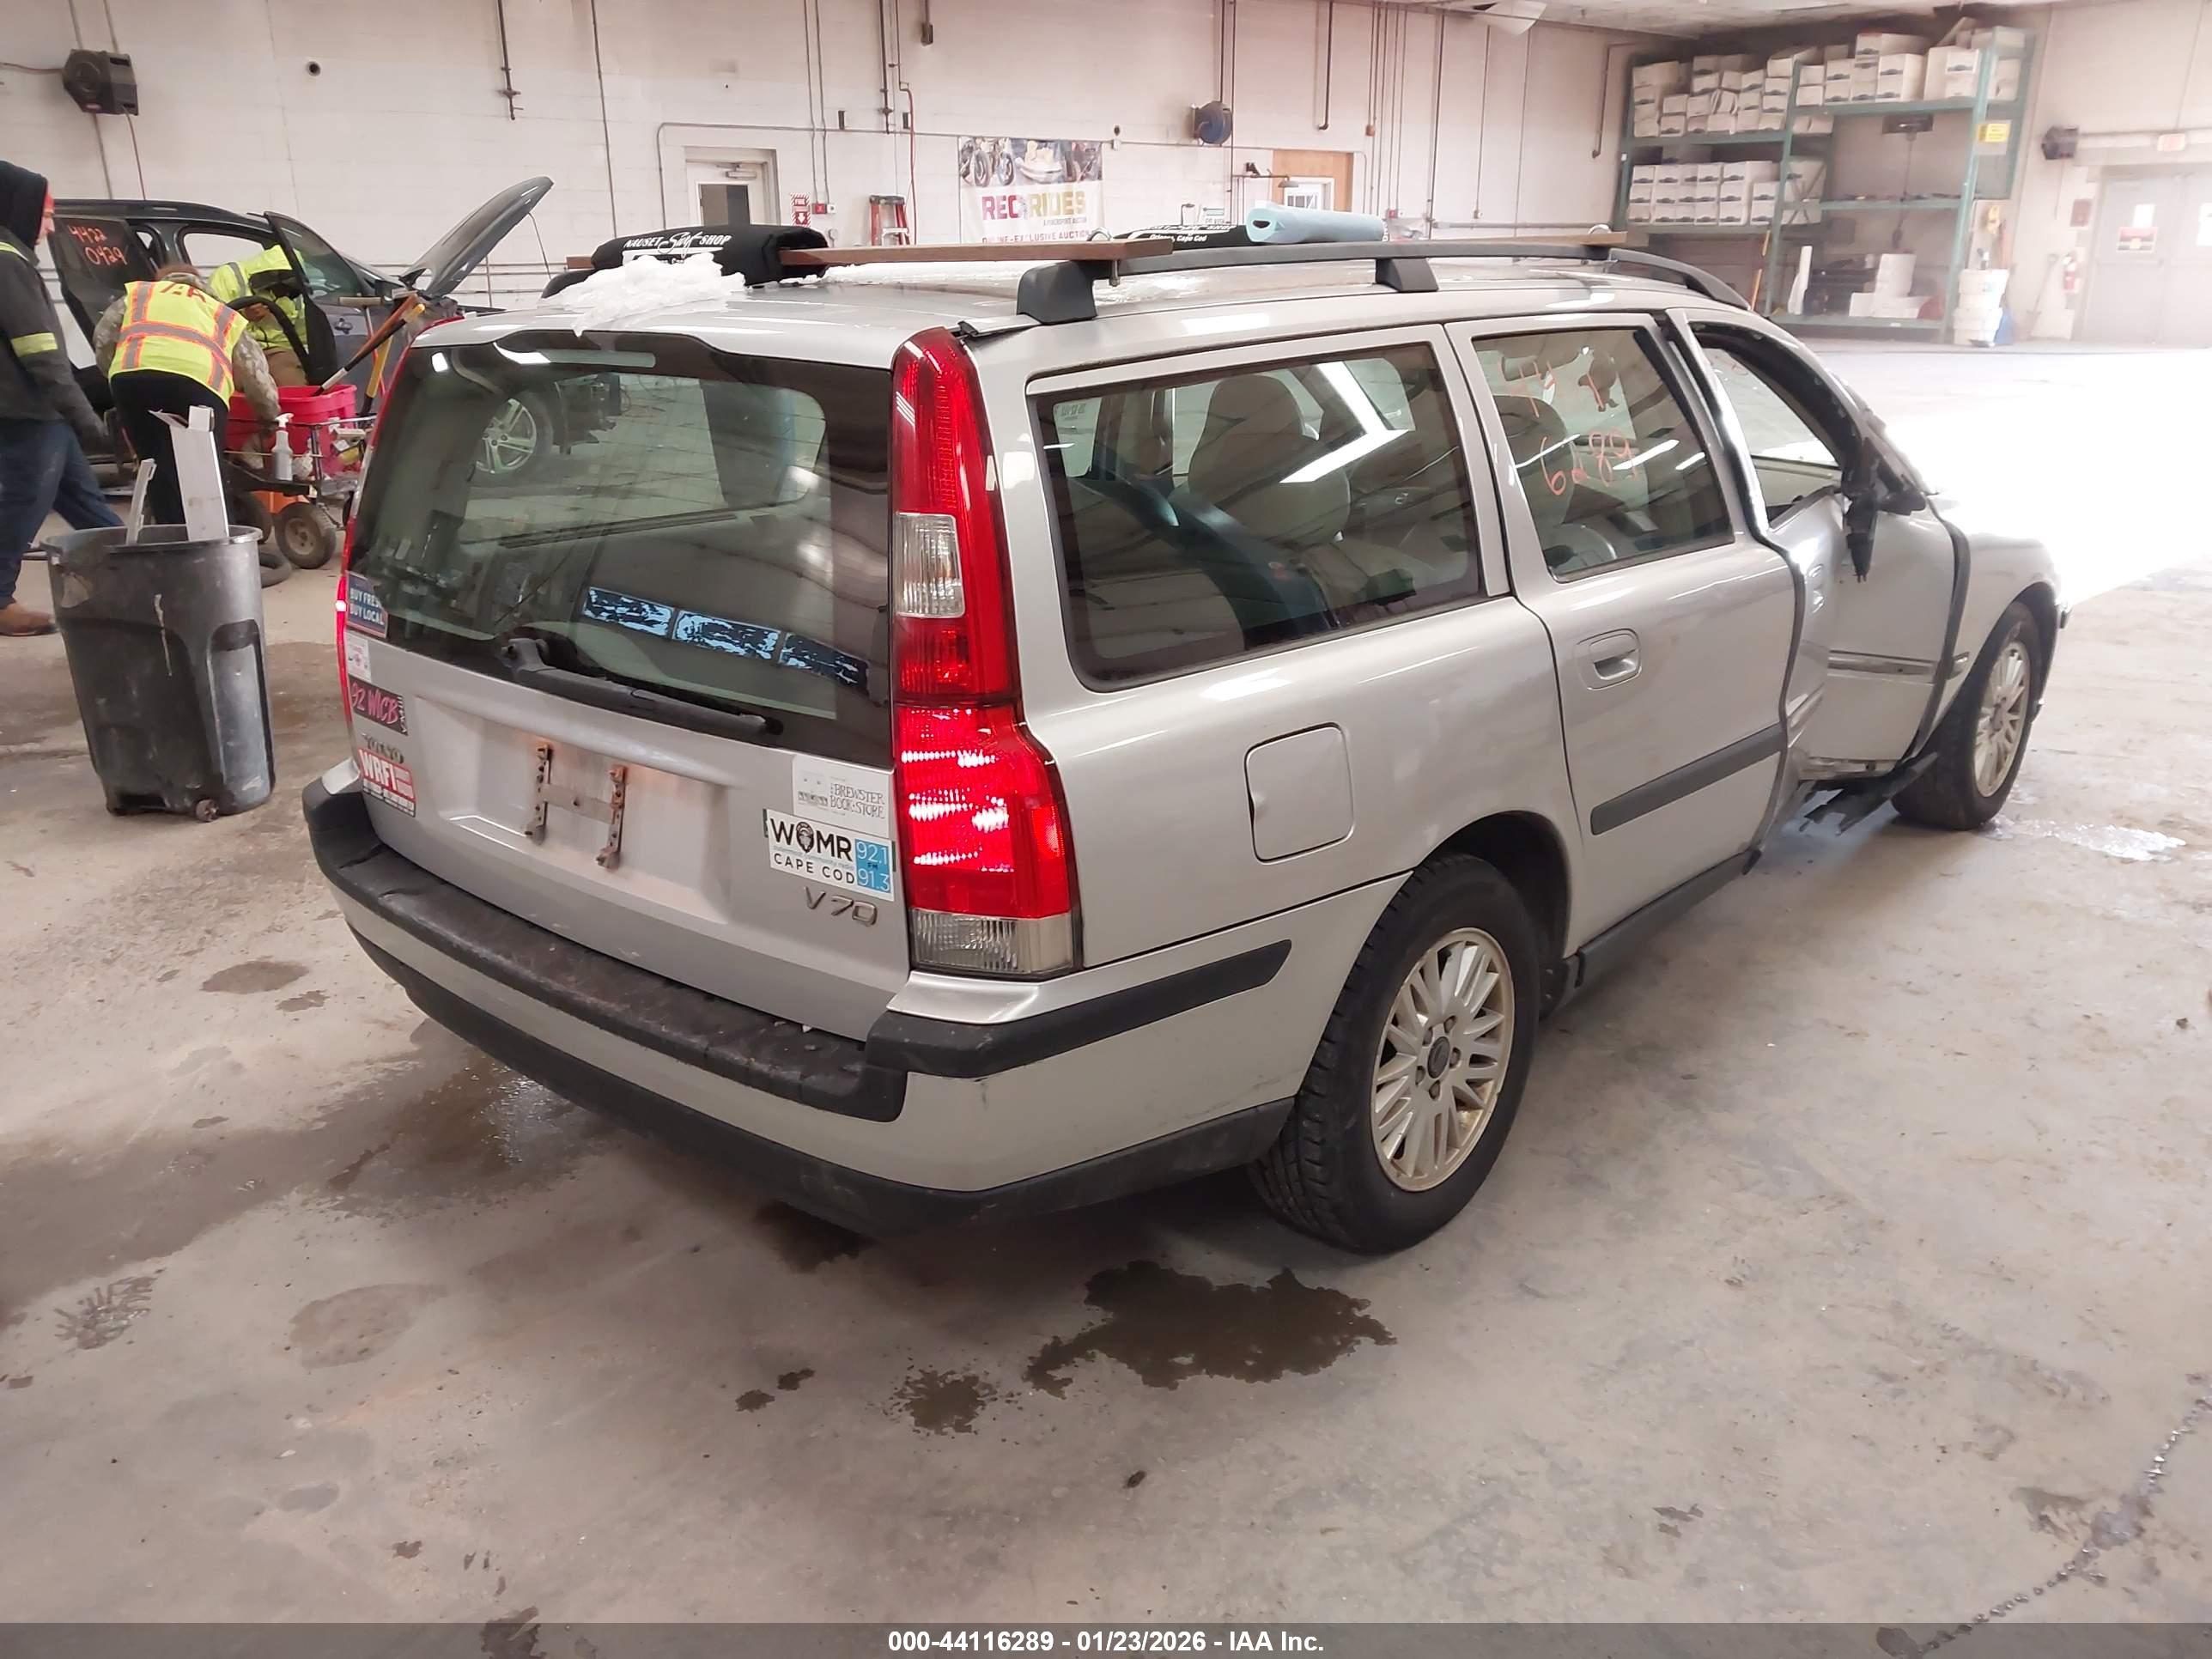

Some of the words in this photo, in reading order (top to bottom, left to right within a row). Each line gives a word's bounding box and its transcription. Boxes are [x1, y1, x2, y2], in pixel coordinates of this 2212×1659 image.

[981, 194, 1019, 220] REC
[67, 225, 107, 244] 4422
[623, 236, 665, 248] NAUSET
[699, 234, 732, 246] SHOP
[85, 245, 128, 265] 0429
[349, 603, 362, 617] BUY
[362, 608, 386, 627] LOCAL
[367, 688, 399, 725] WICB
[834, 783, 885, 805] BREWSTER
[857, 842, 888, 866] 92.1
[774, 853, 814, 874] CAPE
[822, 866, 855, 884] COD
[858, 869, 890, 892] 91.3
